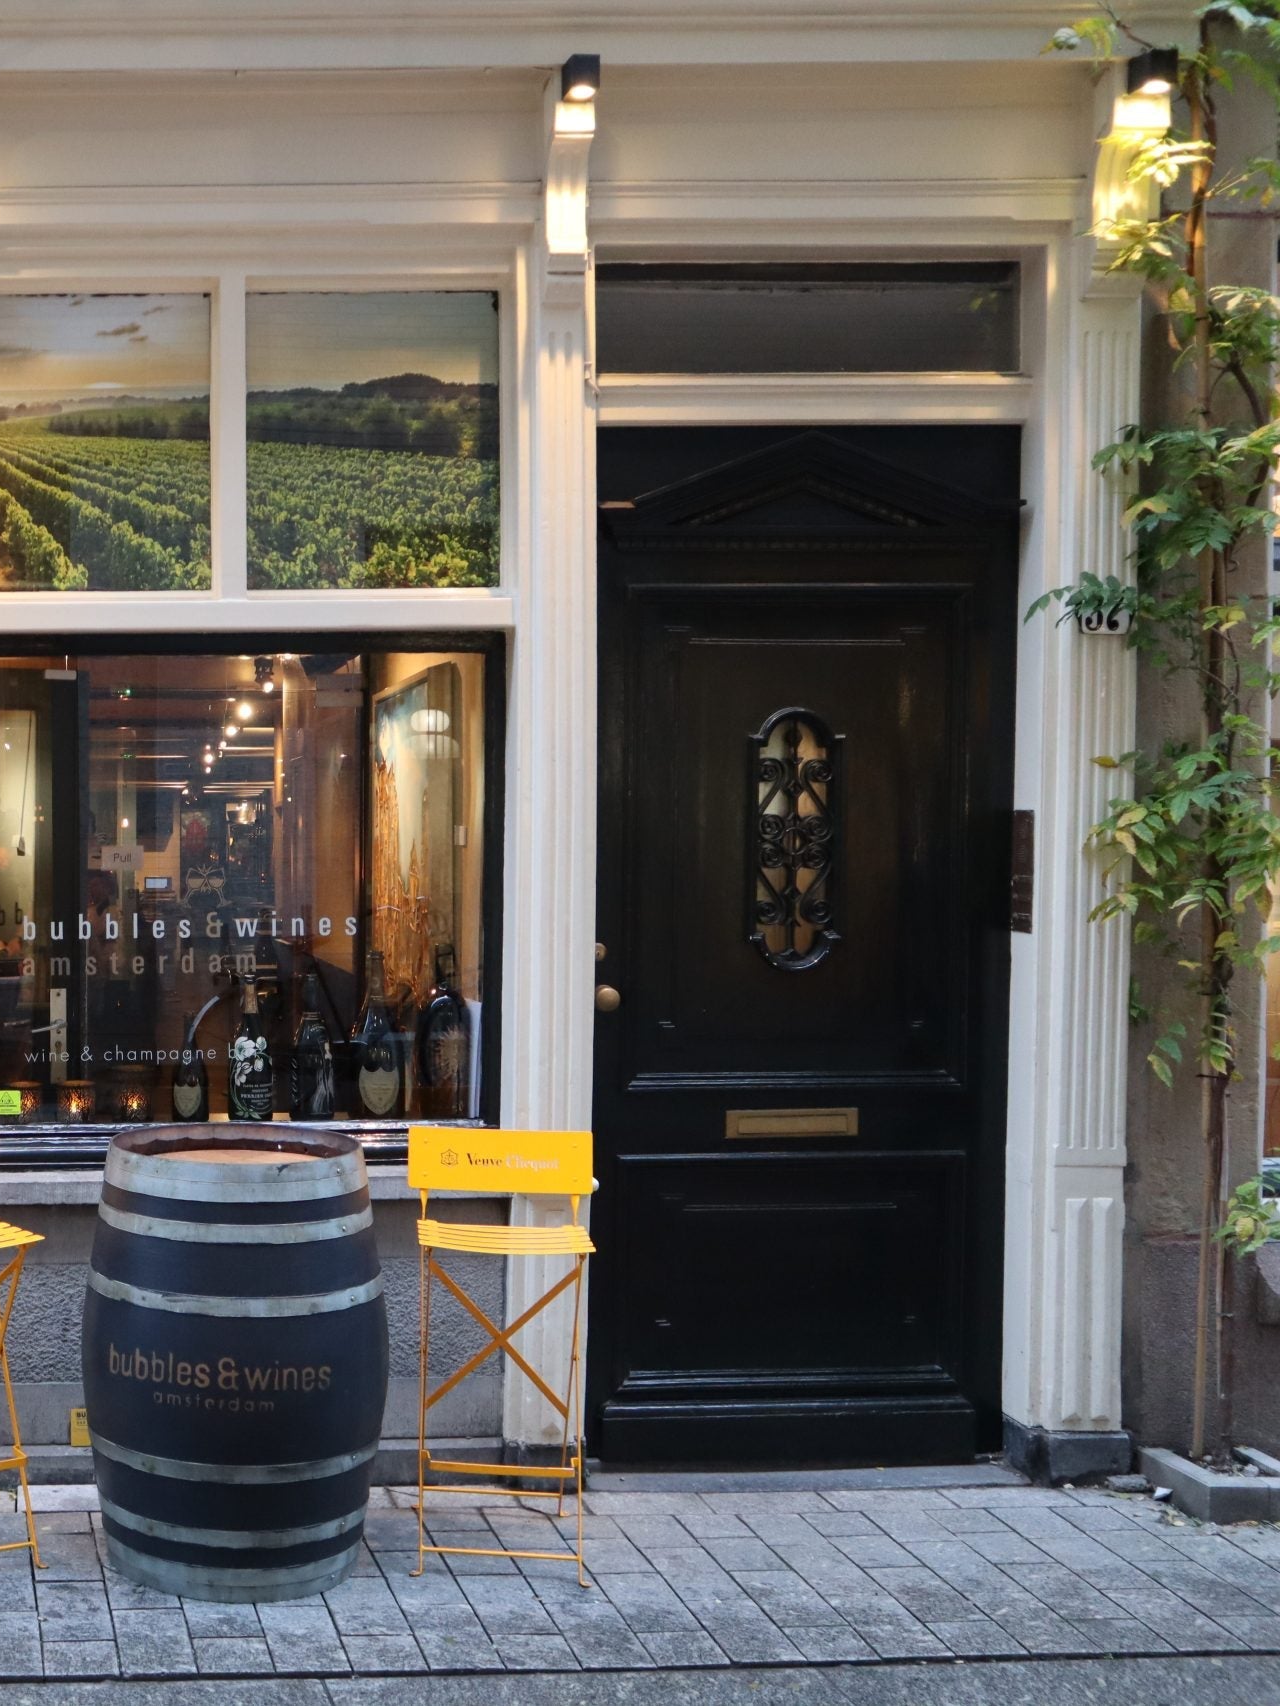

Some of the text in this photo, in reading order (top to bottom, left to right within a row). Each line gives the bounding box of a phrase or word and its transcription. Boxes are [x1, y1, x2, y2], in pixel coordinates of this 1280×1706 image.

[112, 851, 132, 863] Pull
[22, 947, 257, 977] amsterdam
[24, 1046, 70, 1063] wine
[80, 1045, 93, 1062] &
[104, 1043, 217, 1065] champagne
[466, 1152, 559, 1172] Veuve Clicquot
[153, 1391, 275, 1412] amsterdam
